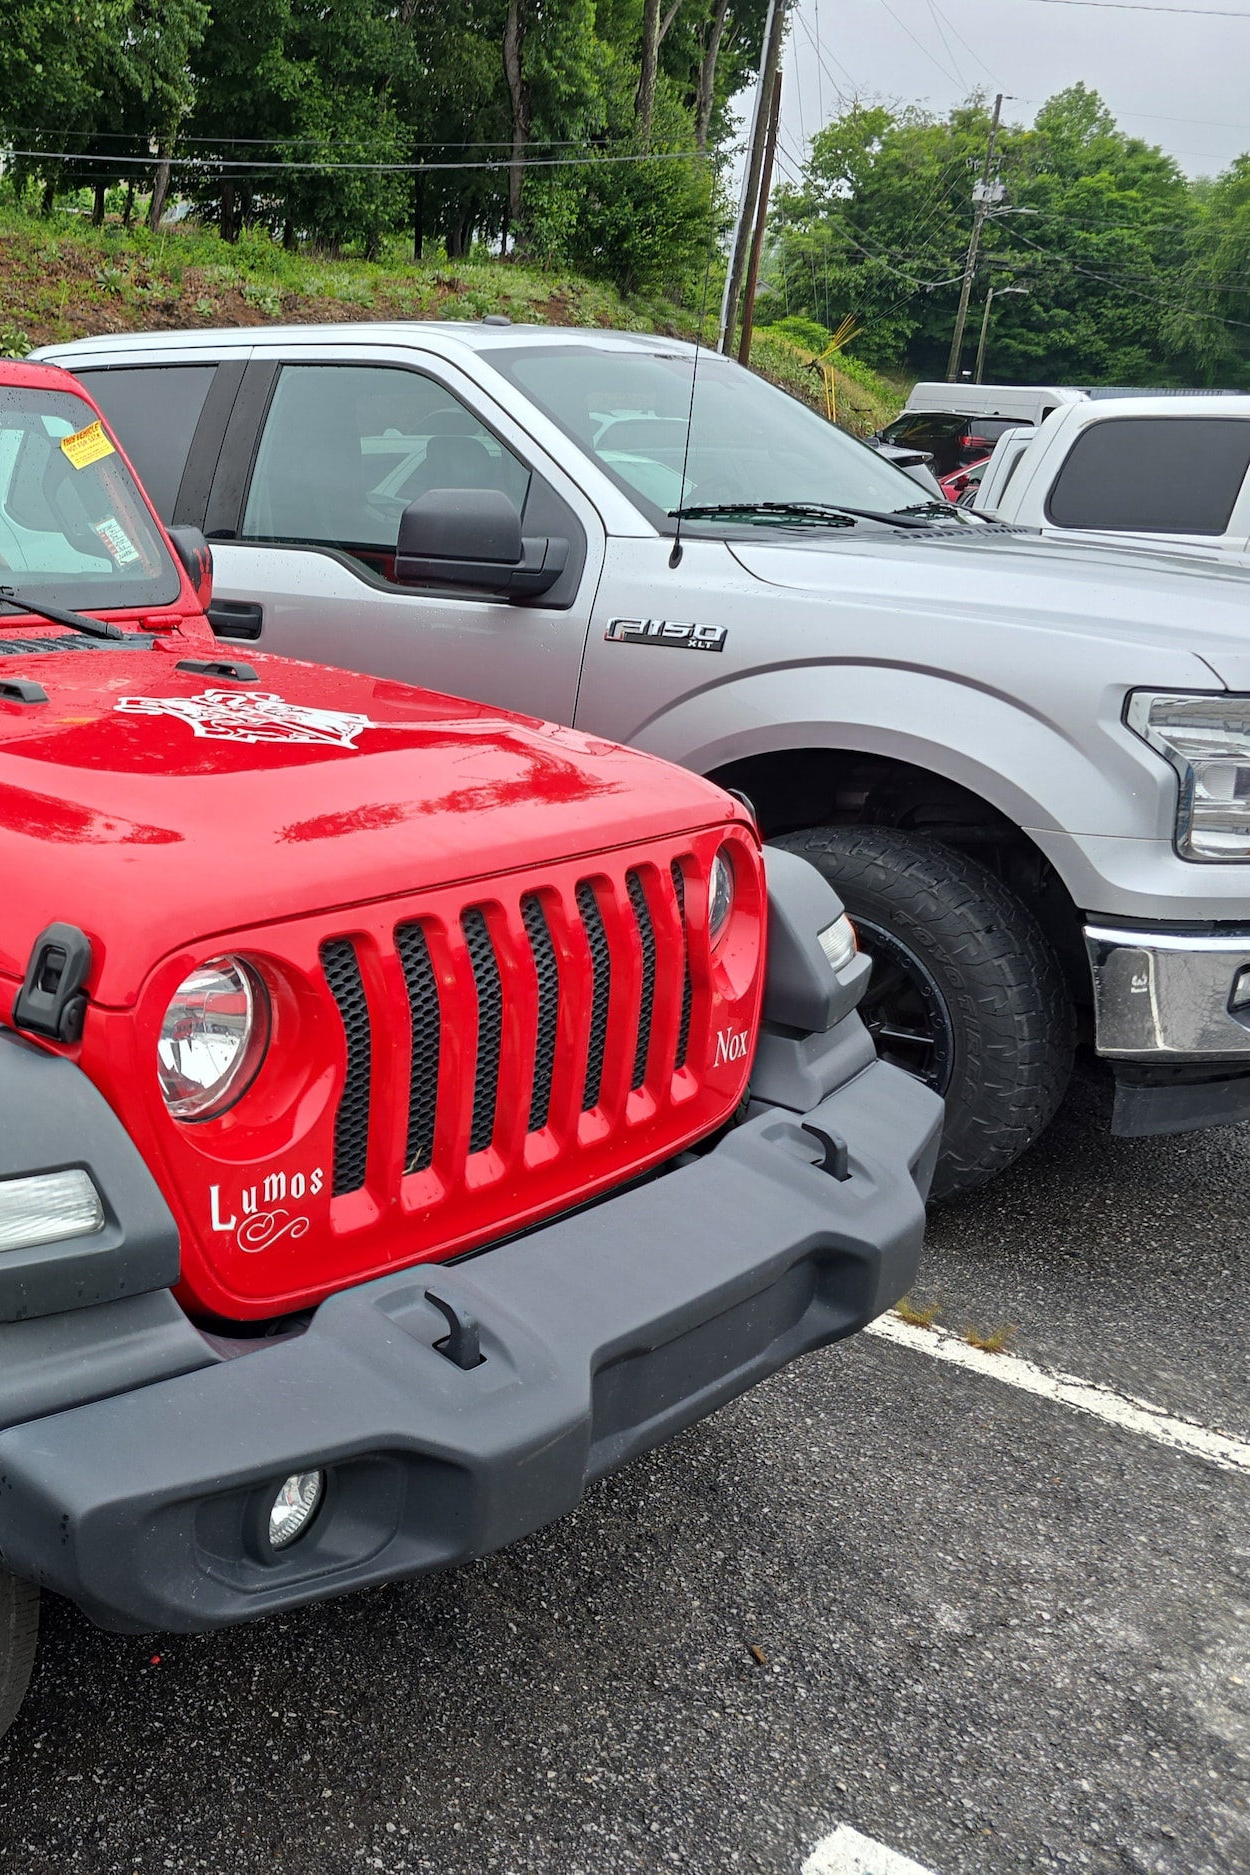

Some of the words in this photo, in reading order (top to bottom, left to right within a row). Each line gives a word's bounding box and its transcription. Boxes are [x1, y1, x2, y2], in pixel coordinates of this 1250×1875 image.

[76, 422, 100, 441] VEHICLE
[687, 639, 715, 650] XLT
[889, 909, 966, 990] TOYO
[712, 1026, 749, 1068] Nox
[209, 1166, 324, 1232] Lumos
